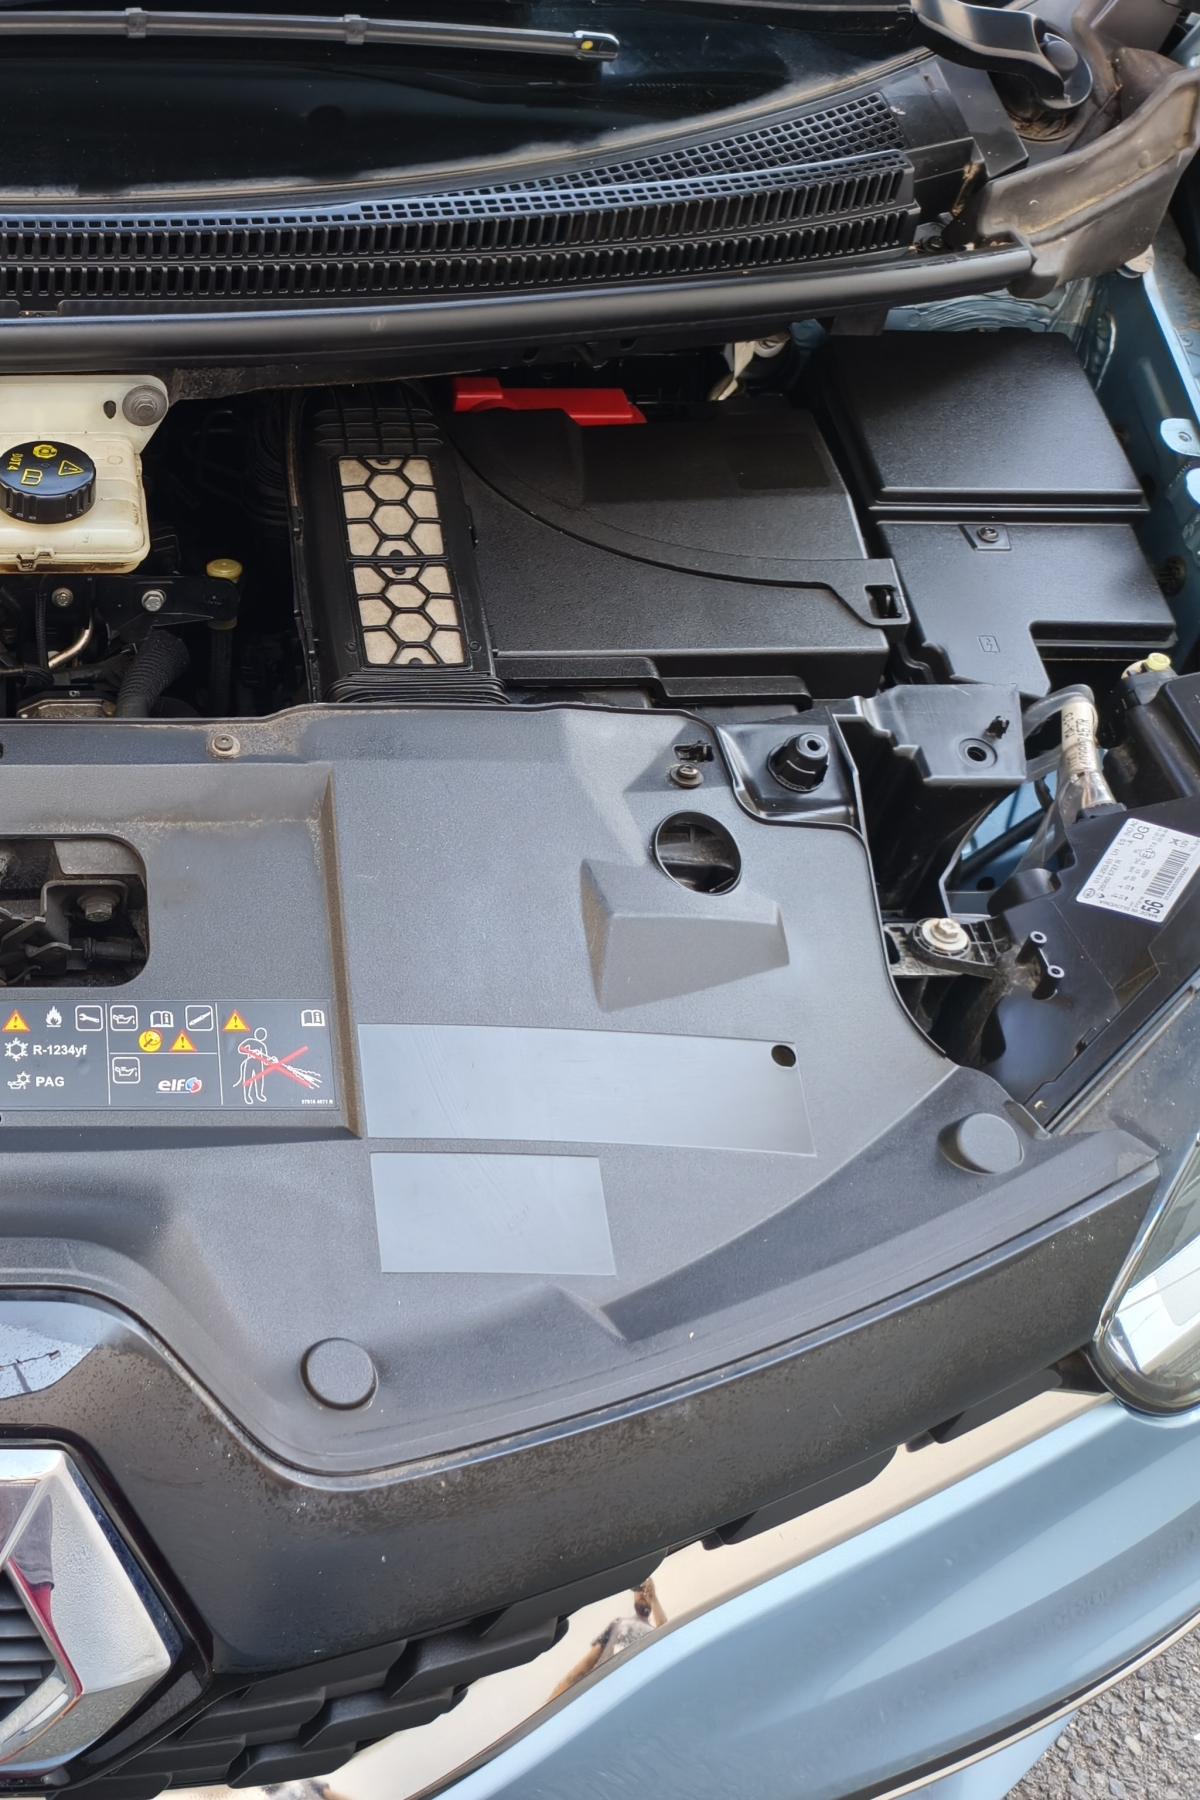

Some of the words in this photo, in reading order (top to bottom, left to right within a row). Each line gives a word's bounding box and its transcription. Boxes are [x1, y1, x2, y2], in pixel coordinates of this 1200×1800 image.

[1133, 824, 1149, 840] DG
[1141, 898, 1164, 914] 56
[33, 1044, 87, 1057] R-1234yf
[35, 1076, 65, 1087] PAG
[158, 1078, 186, 1091] elf
